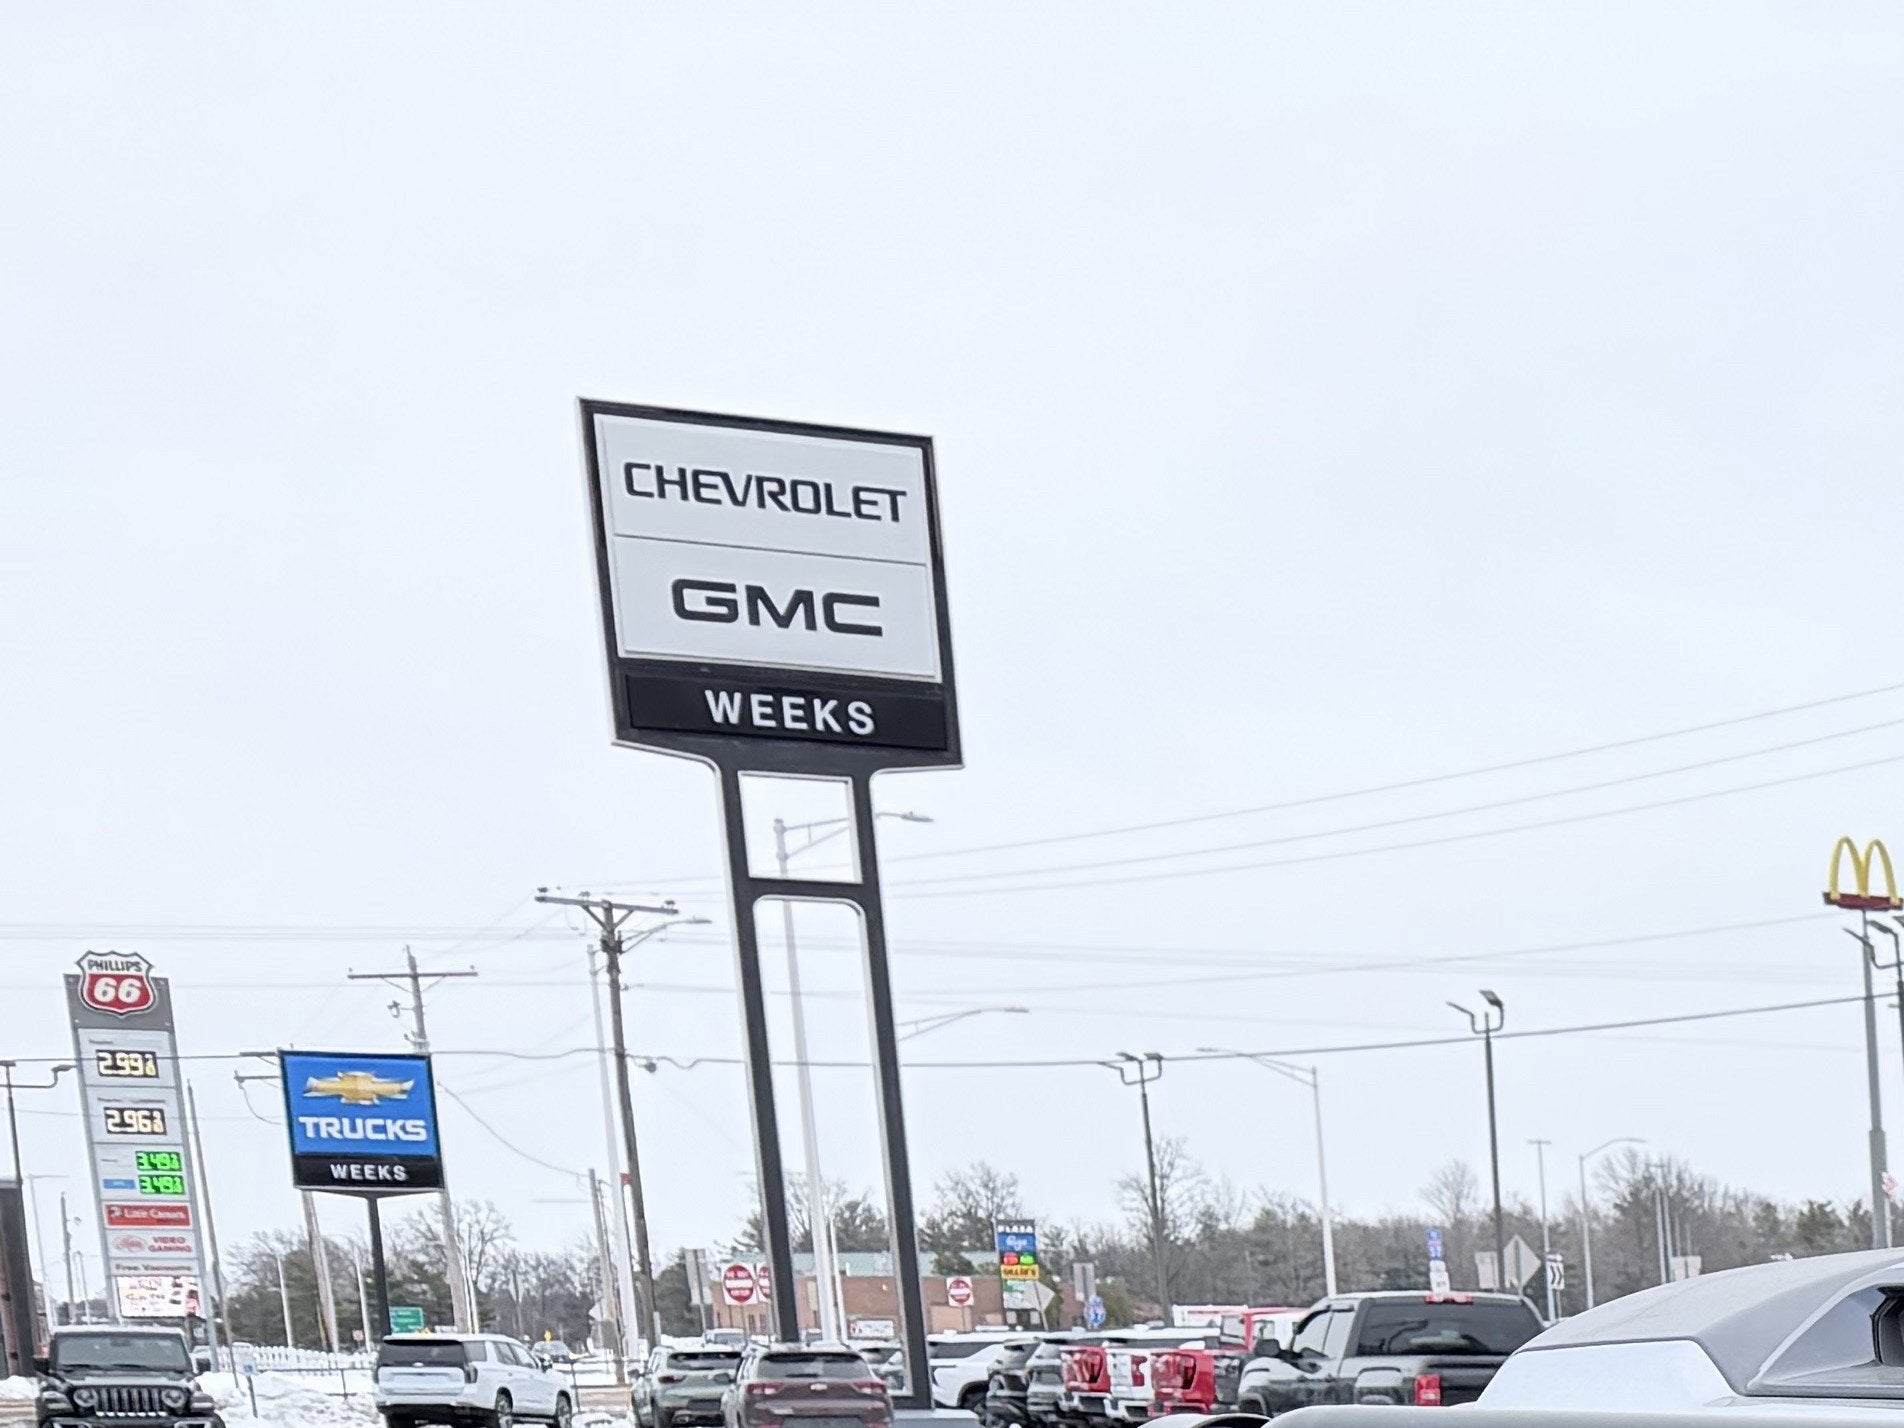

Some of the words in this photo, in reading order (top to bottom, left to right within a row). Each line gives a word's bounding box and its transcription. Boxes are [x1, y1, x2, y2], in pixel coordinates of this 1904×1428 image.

[624, 462, 907, 522] CHEVROLET
[671, 578, 883, 637] GMC
[704, 689, 875, 735] WEEKS
[87, 959, 142, 972] PHILLIPS
[93, 977, 142, 1004] 66
[298, 1116, 428, 1142] TRUCKS
[330, 1163, 408, 1182] WEEKS
